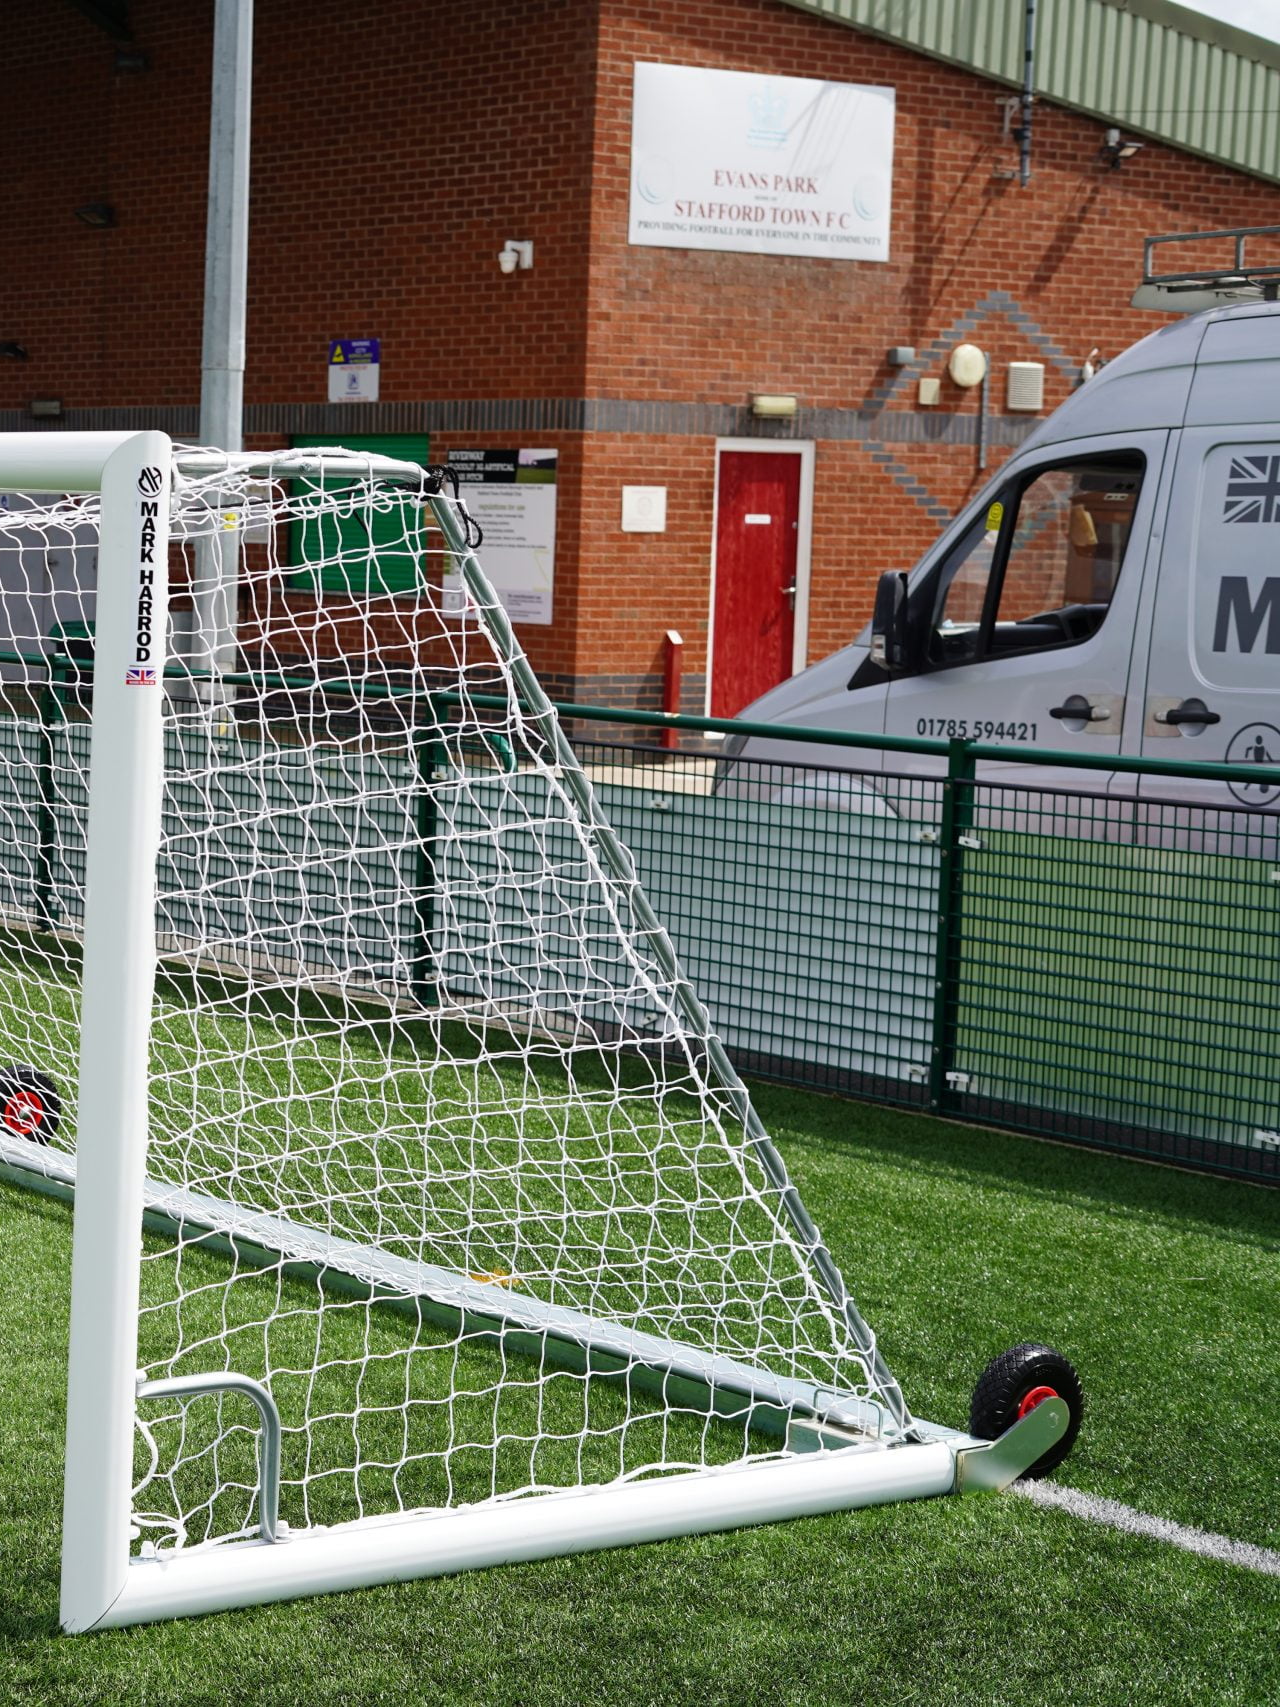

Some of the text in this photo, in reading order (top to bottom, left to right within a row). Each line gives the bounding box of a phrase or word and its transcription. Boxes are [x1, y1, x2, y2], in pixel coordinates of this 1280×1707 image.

[714, 169, 819, 194] EVANS PARK
[674, 199, 765, 222] STAFFORD
[770, 206, 821, 227] TOWN
[638, 220, 881, 246] PROVIDING FOOTBALL FOR EVERYONE IN THE COMMUNITY
[140, 501, 158, 563] MARK
[135, 569, 154, 663] HARROD
[916, 718, 1038, 742] 01785 594421
